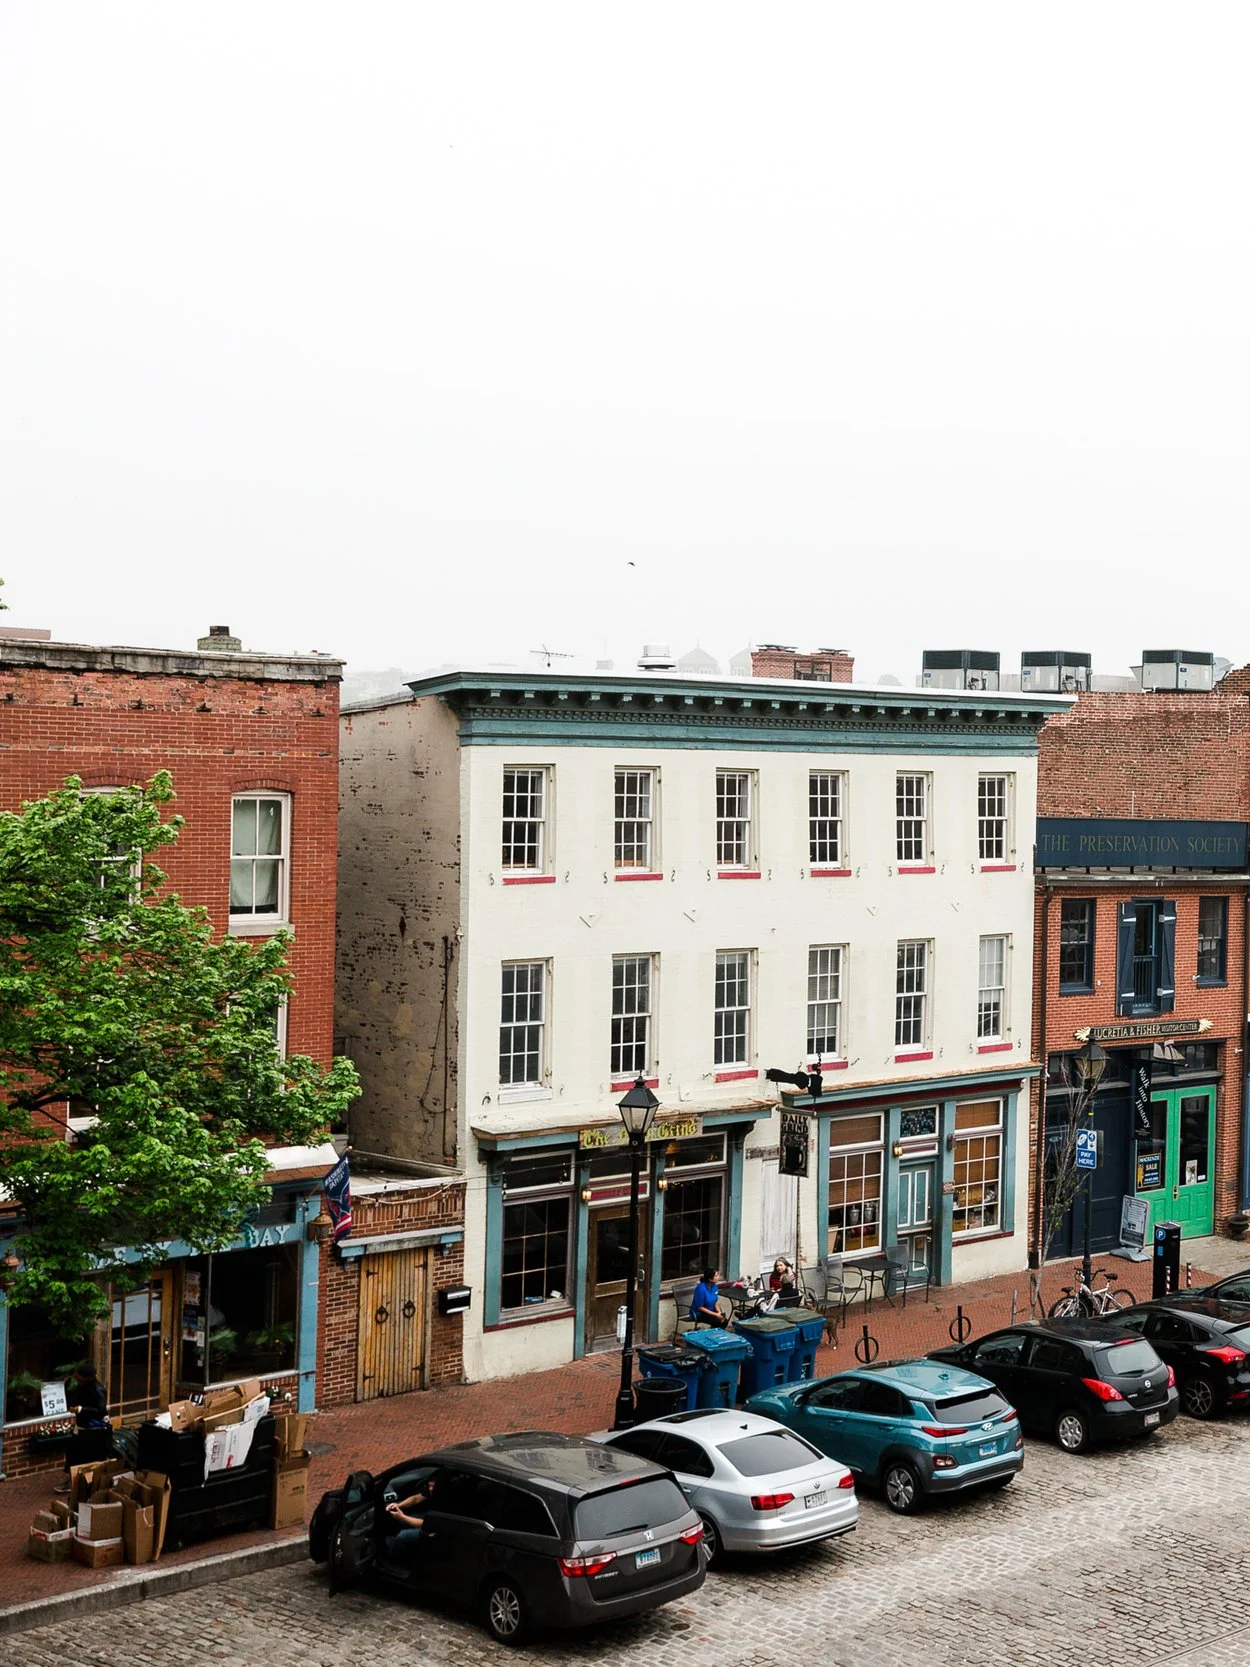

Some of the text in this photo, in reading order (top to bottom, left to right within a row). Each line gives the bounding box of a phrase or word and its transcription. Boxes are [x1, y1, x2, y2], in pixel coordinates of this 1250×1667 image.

[1042, 833, 1242, 853] THE PRESERVATION SOCIETY
[1129, 1027, 1136, 1036] &
[1136, 1025, 1160, 1036] FISHER
[1139, 1067, 1150, 1089] Walk
[1138, 1085, 1148, 1102] into
[782, 1113, 808, 1125] DAILY
[1135, 1099, 1151, 1128] History
[583, 1129, 610, 1148] The
[657, 1118, 698, 1138] Grind
[781, 1122, 808, 1133] GRIND
